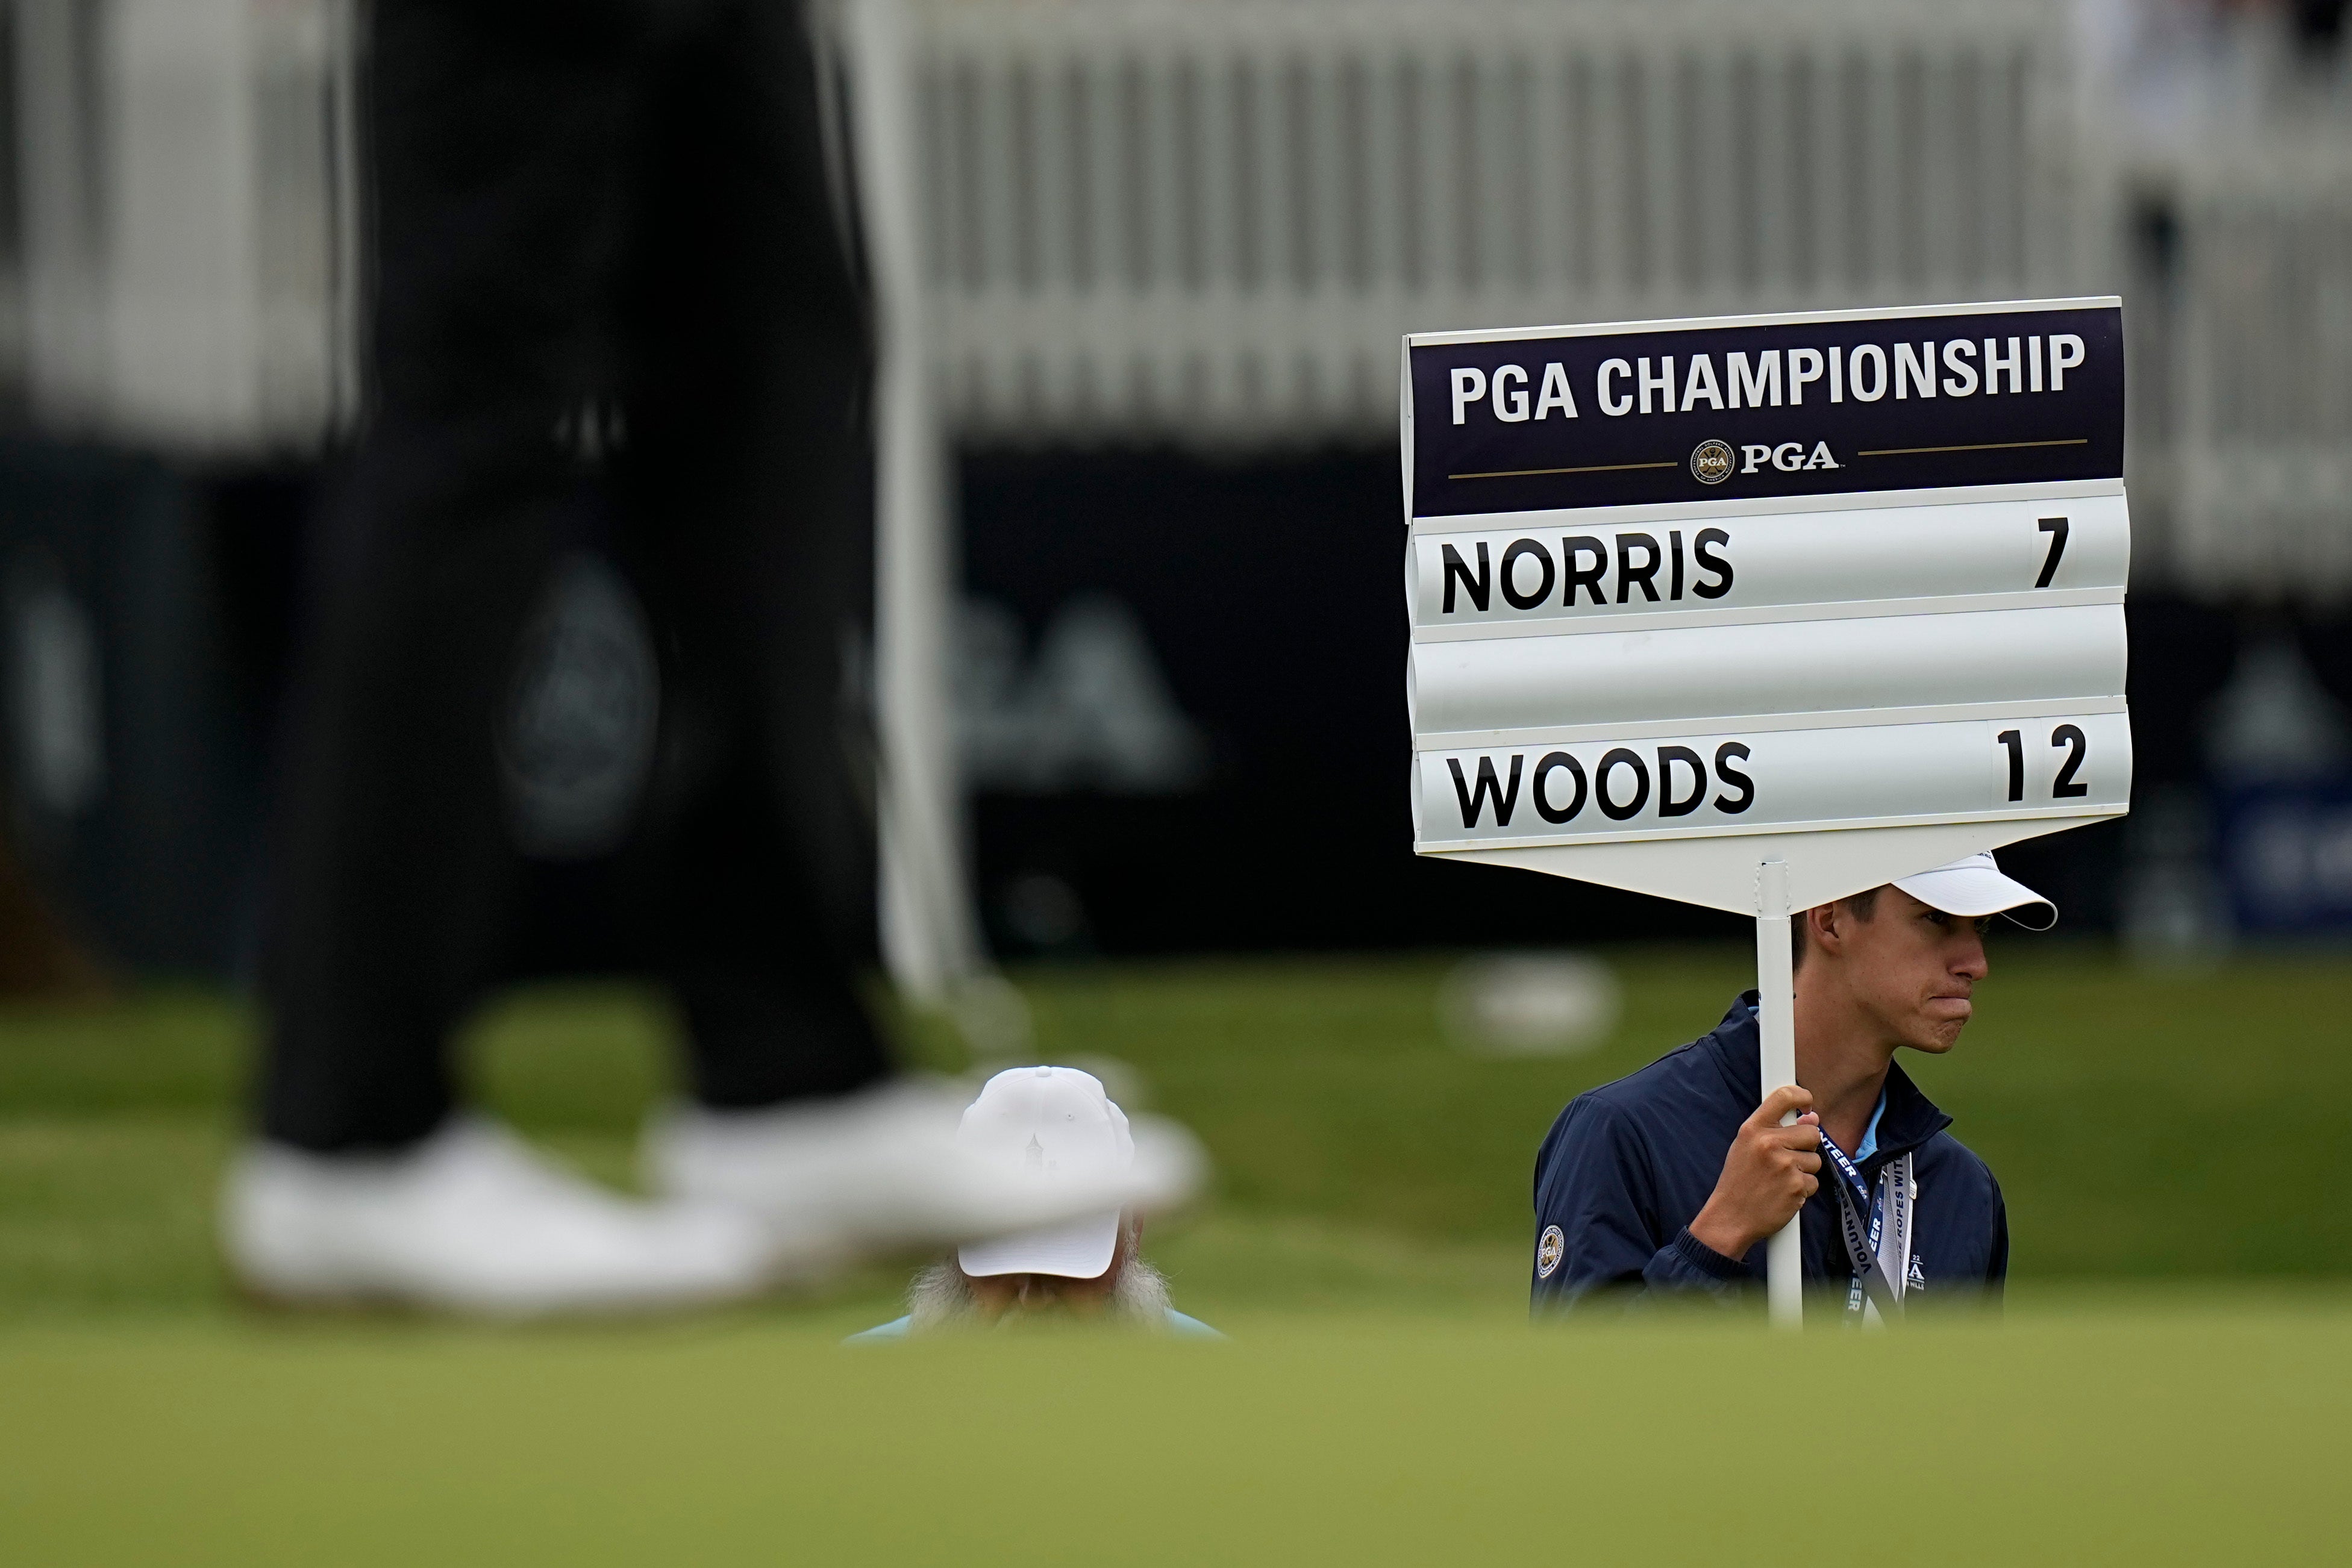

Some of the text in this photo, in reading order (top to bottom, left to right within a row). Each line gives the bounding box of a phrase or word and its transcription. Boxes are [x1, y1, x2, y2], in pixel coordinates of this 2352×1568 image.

[1450, 333, 2086, 425] PGA CHAMPIONSHIP
[1698, 457, 1727, 467] PGA
[1741, 441, 1839, 473] PGA
[1441, 517, 2069, 614] NORRIS 7
[1446, 742, 1754, 829] WOODS
[1817, 1126, 1857, 1177] NTEER
[1894, 1158, 1903, 1187] WIT
[1895, 1191, 1904, 1238] ROPES
[1540, 1246, 1557, 1258] PGA
